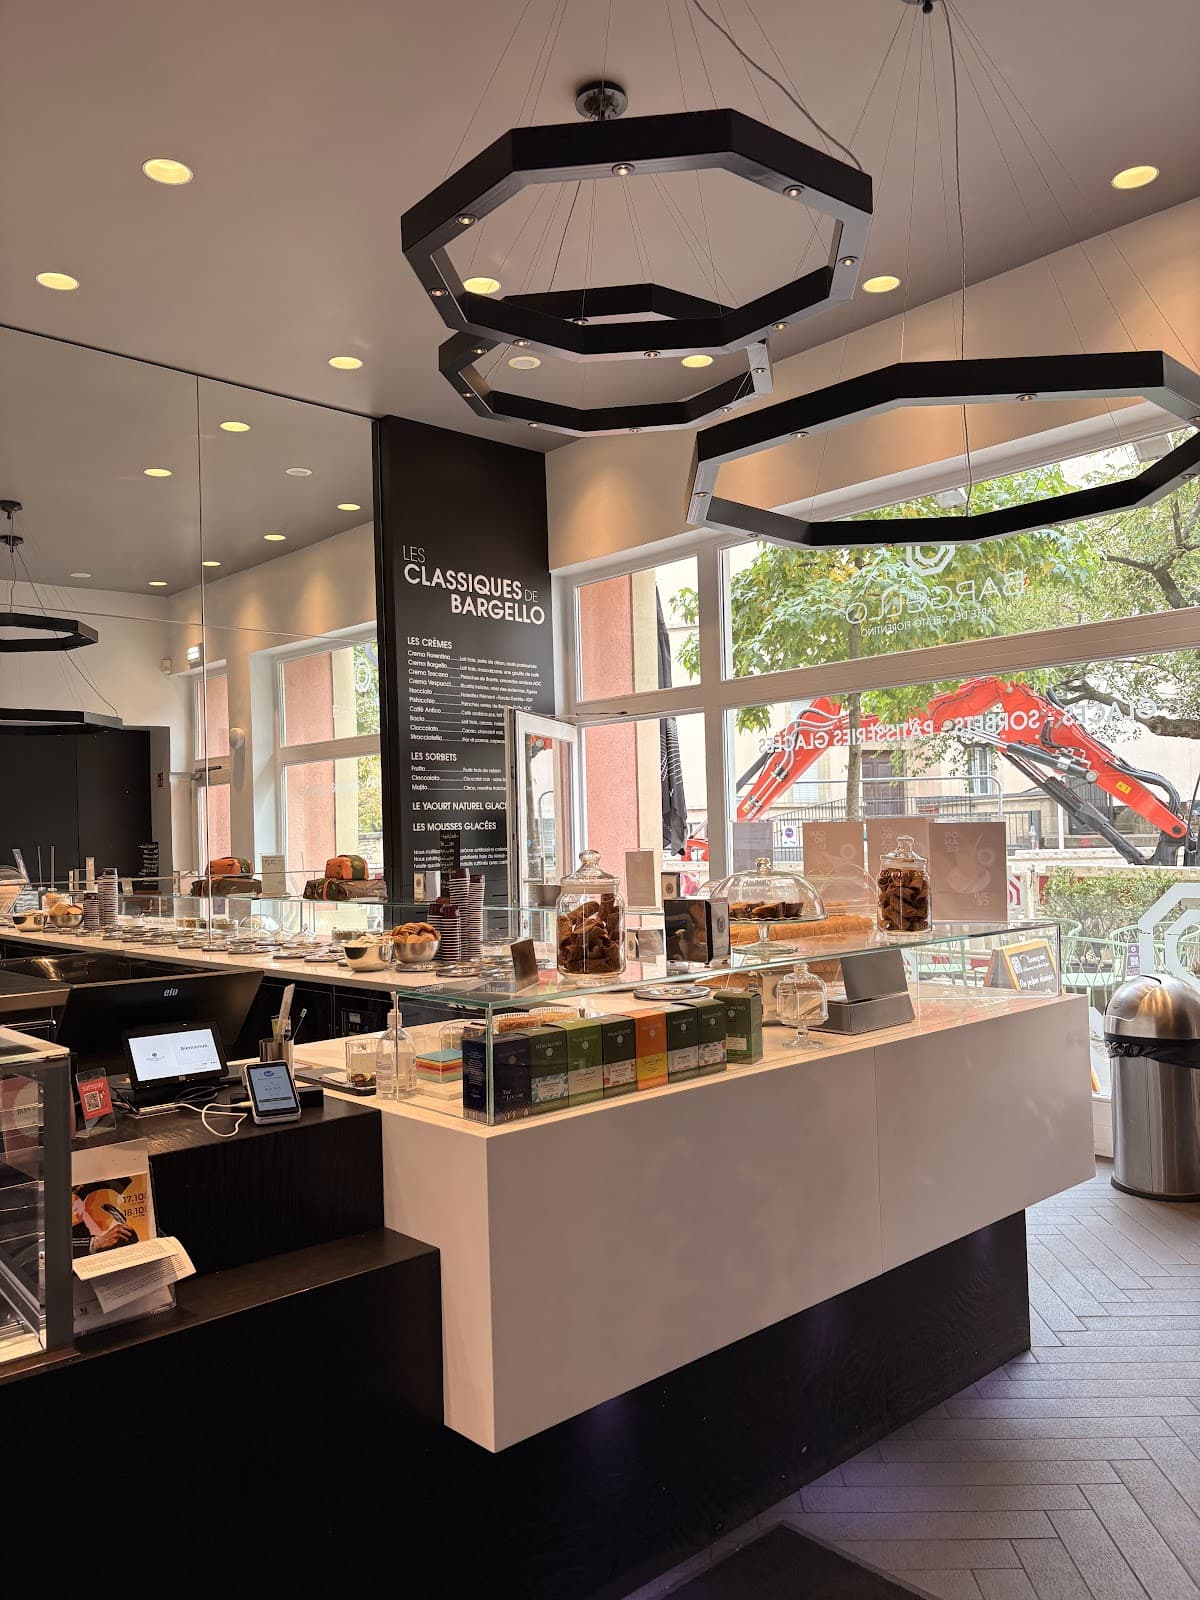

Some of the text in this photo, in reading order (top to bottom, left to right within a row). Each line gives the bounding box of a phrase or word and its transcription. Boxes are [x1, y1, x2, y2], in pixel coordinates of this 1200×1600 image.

[402, 545, 426, 563] LES
[404, 563, 539, 602] CLASSIQUES DE
[451, 594, 545, 625] BARGELLO
[407, 637, 453, 649] LES CRÈMES
[411, 752, 457, 762] LES SORBETS
[412, 802, 421, 811] LE
[422, 802, 451, 810] YAOURT
[452, 802, 484, 810] NATUREL
[413, 820, 497, 832] LES MOUSSES GLACÉES
[163, 987, 179, 997] elo
